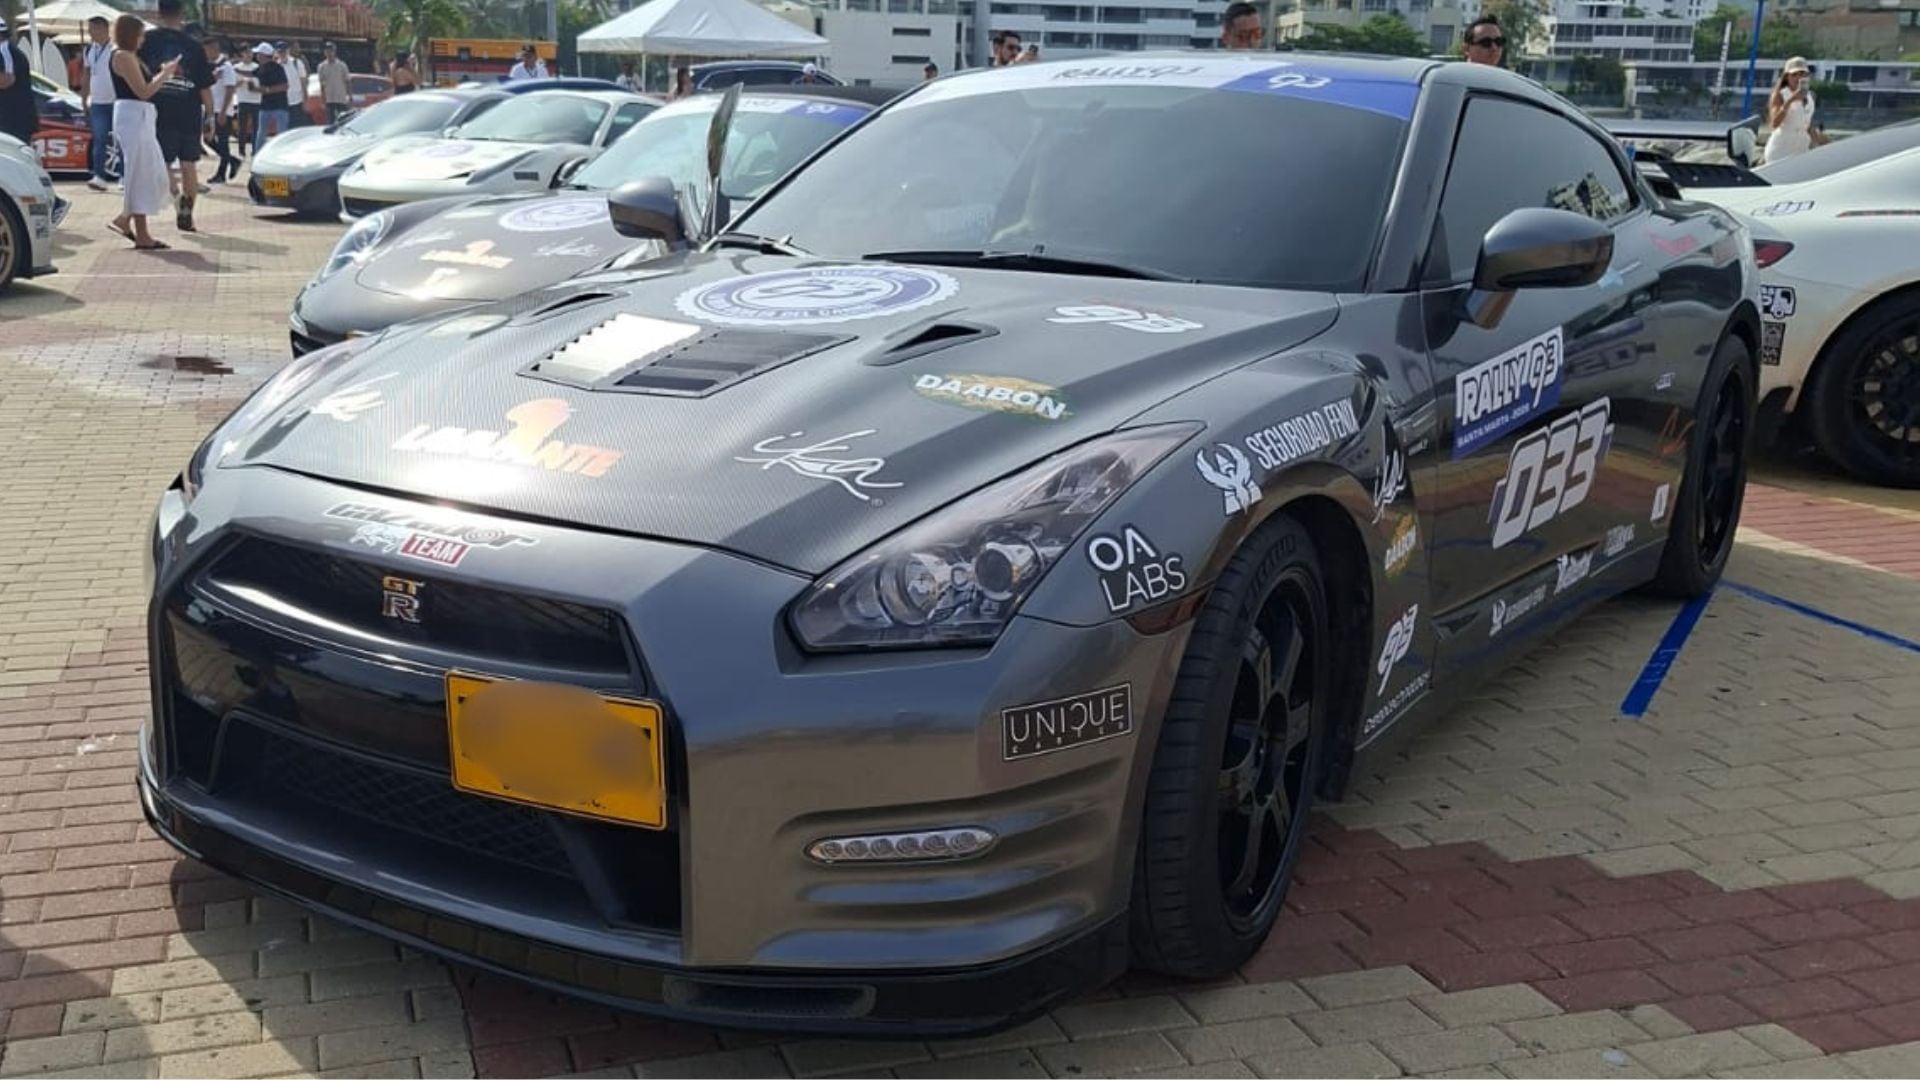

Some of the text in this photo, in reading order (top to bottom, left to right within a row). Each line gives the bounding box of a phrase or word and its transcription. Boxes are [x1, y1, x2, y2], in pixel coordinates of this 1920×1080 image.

[31, 138, 68, 158] 15
[915, 374, 1066, 420] DAABON
[1245, 397, 1359, 470] SEGURIDAD FENIX
[1491, 404, 1610, 549] 033
[407, 534, 457, 565] TEAM
[382, 575, 425, 596] GT
[382, 590, 421, 624] R
[1102, 557, 1185, 611] LABS
[1010, 693, 1124, 742] UNIQUE
